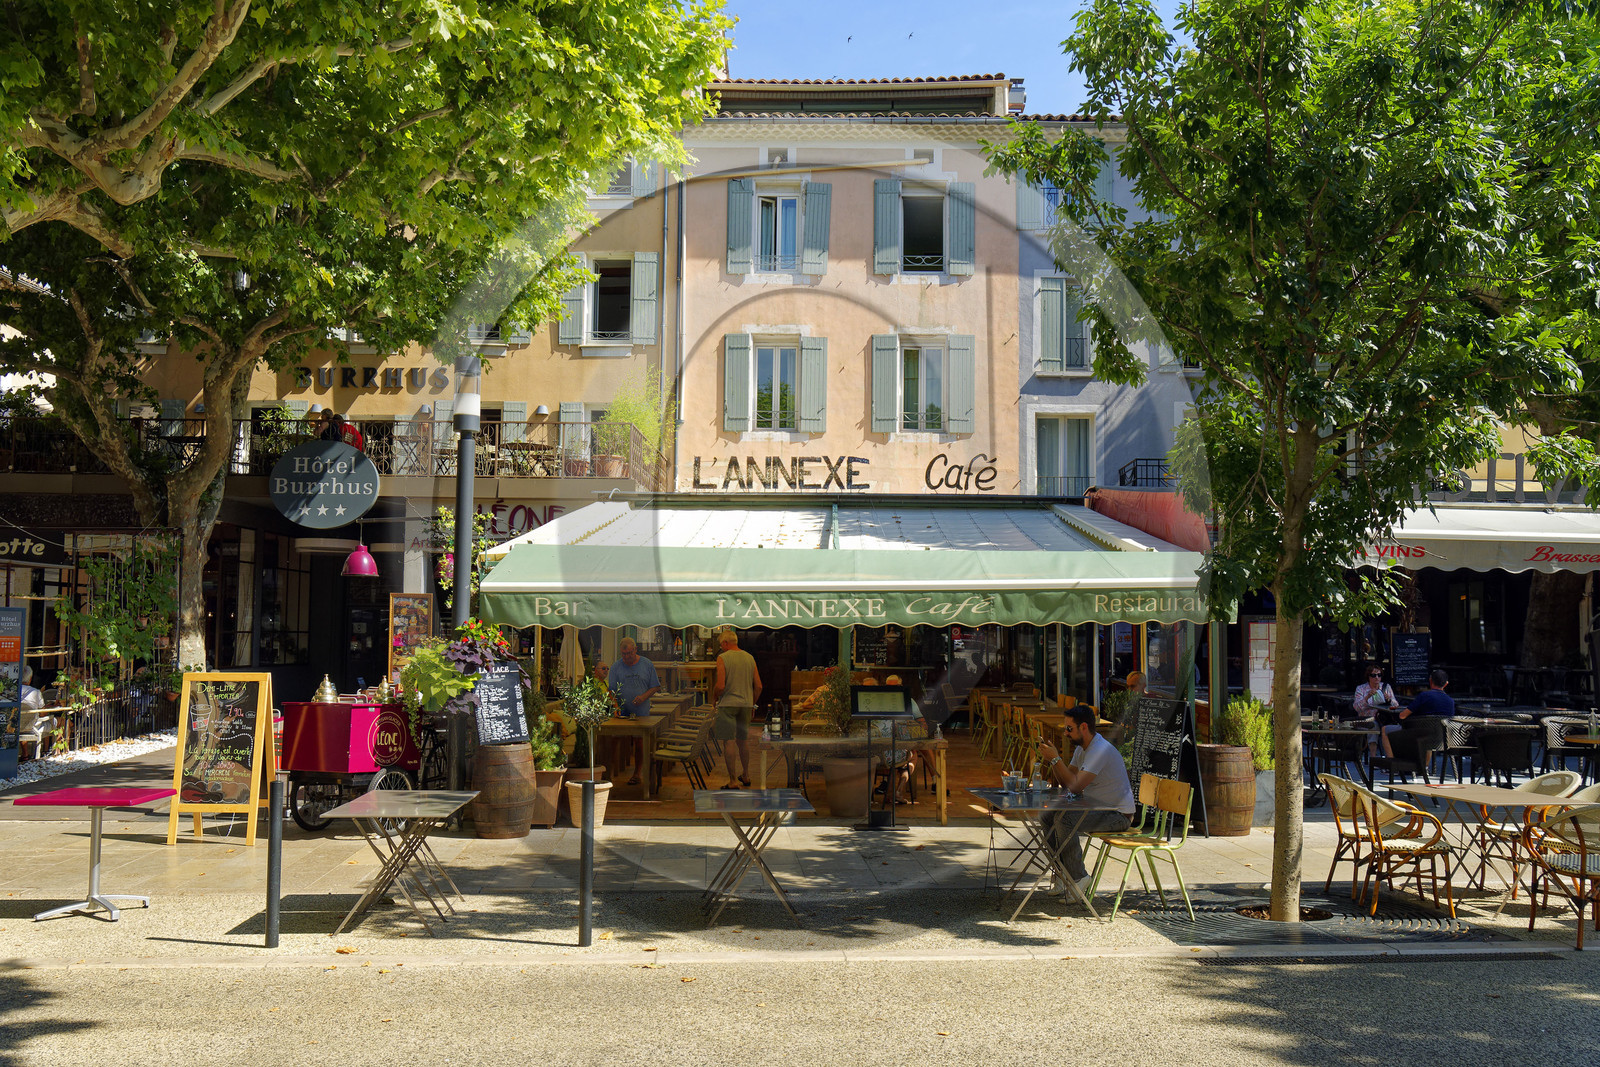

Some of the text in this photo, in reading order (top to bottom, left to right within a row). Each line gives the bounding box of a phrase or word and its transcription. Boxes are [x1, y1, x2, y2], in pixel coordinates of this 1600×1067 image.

[297, 366, 449, 388] BURRHUS
[293, 456, 356, 474] Hôtel
[693, 455, 870, 490] L'ANNEXE
[925, 453, 997, 490] Café
[273, 477, 373, 495] Burrhus
[1375, 545, 1426, 558] VINS
[535, 597, 583, 616] Bar
[715, 598, 887, 619] L'ANNEXE
[905, 595, 995, 621] Café
[377, 731, 398, 746] LÉONE
